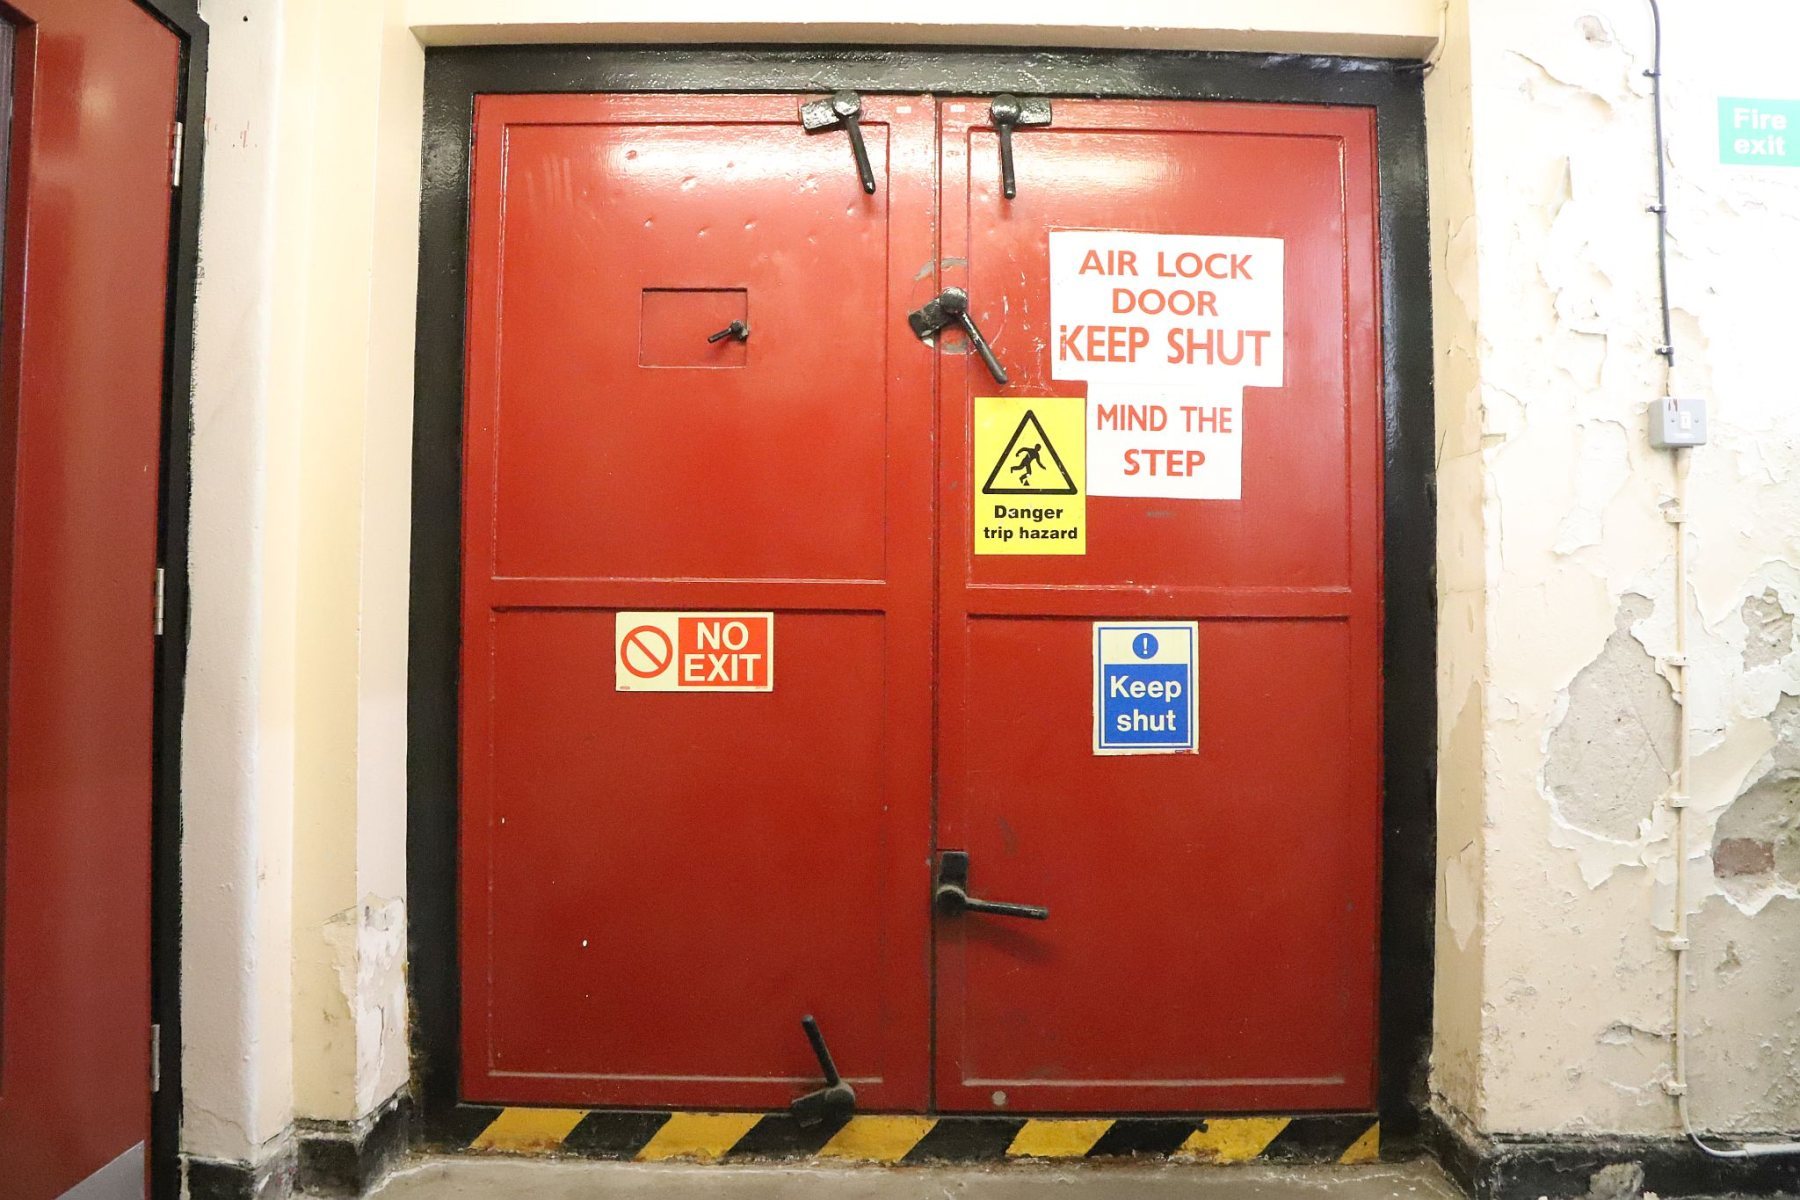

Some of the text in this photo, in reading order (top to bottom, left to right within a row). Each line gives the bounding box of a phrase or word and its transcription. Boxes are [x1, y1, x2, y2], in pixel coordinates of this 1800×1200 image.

[1733, 107, 1787, 130] Fire
[1733, 135, 1786, 156] exit
[1078, 249, 1254, 280] AIR LOCK
[1112, 288, 1219, 316] DOOR
[1059, 325, 1271, 366] KEEP SHUT
[1097, 404, 1233, 434] MIND THE
[1123, 449, 1206, 477] STEP
[994, 505, 1064, 522] Danger
[984, 527, 1078, 542] trip hazard
[697, 621, 749, 651] NO
[684, 653, 762, 681] EXIT
[1110, 675, 1182, 703] Keep
[1116, 709, 1177, 732] shut
